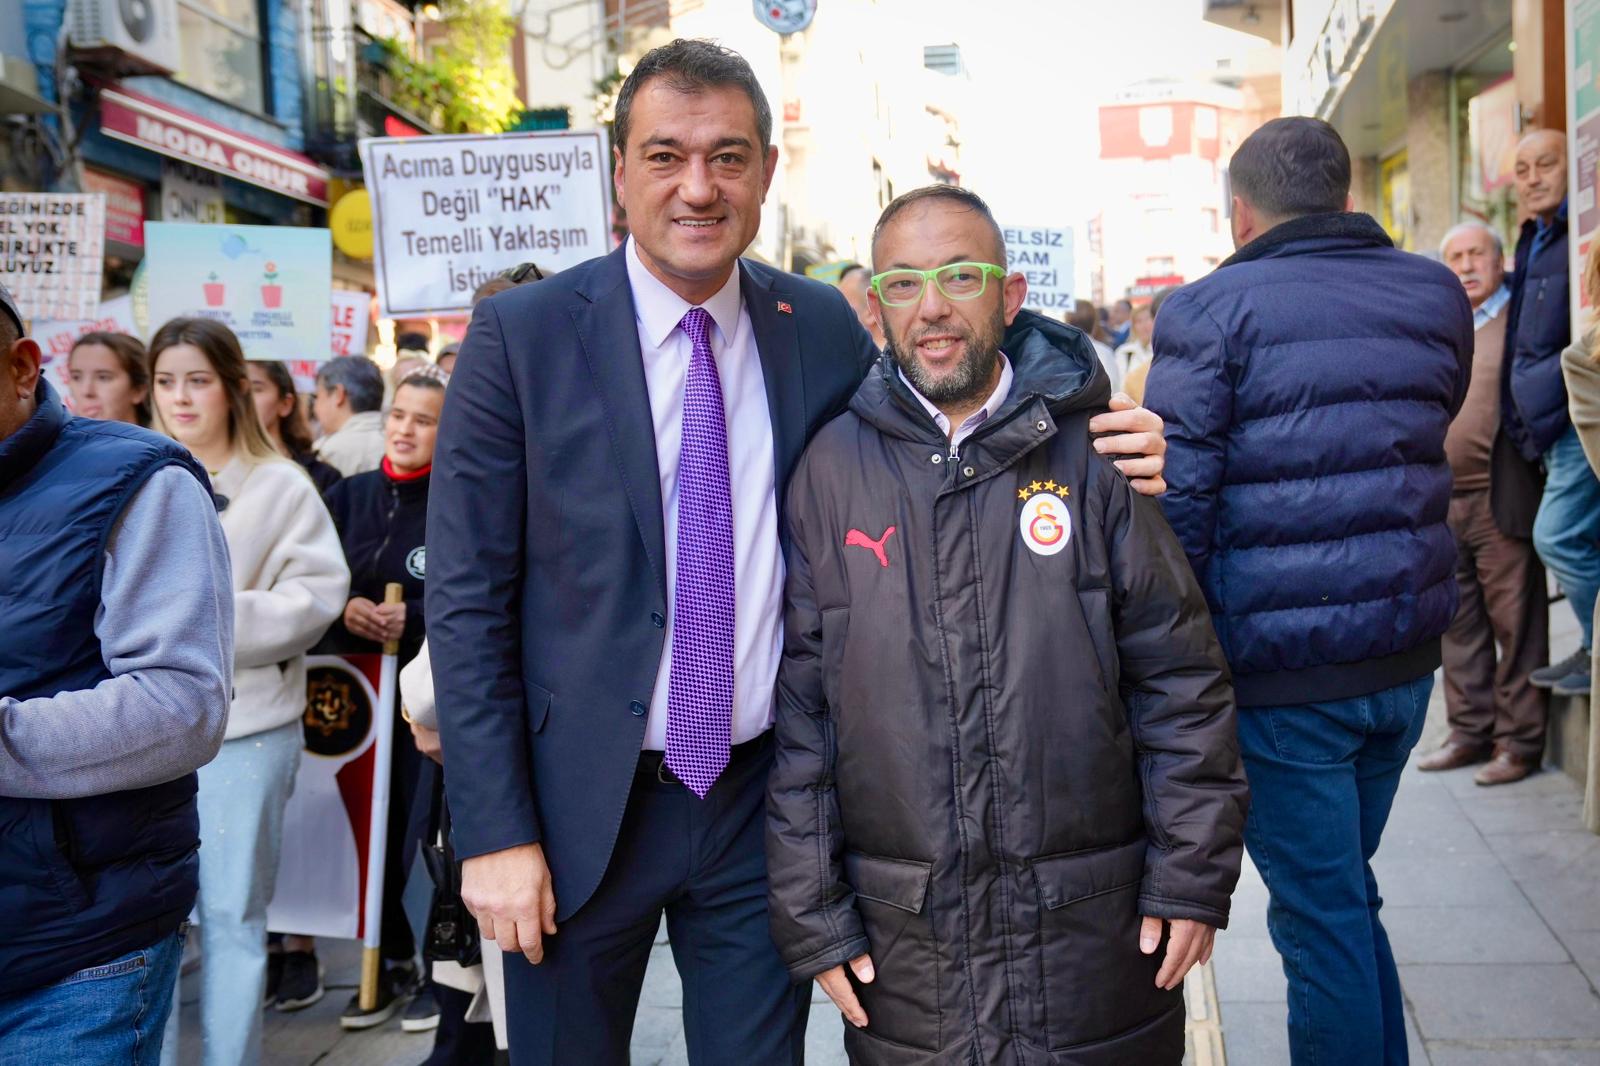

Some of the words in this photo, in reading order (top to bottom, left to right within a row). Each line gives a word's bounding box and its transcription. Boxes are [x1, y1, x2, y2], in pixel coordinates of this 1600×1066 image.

[136, 115, 230, 168] MODA
[231, 150, 309, 194] ONUR
[382, 153, 454, 179] Acıma
[461, 145, 593, 180] Duygusuyla
[422, 189, 480, 221] Değil
[401, 223, 483, 256] Temelli
[488, 224, 589, 255] Yaklaşım
[1004, 229, 1063, 247] ELSİZ
[1027, 292, 1069, 308] RUZ
